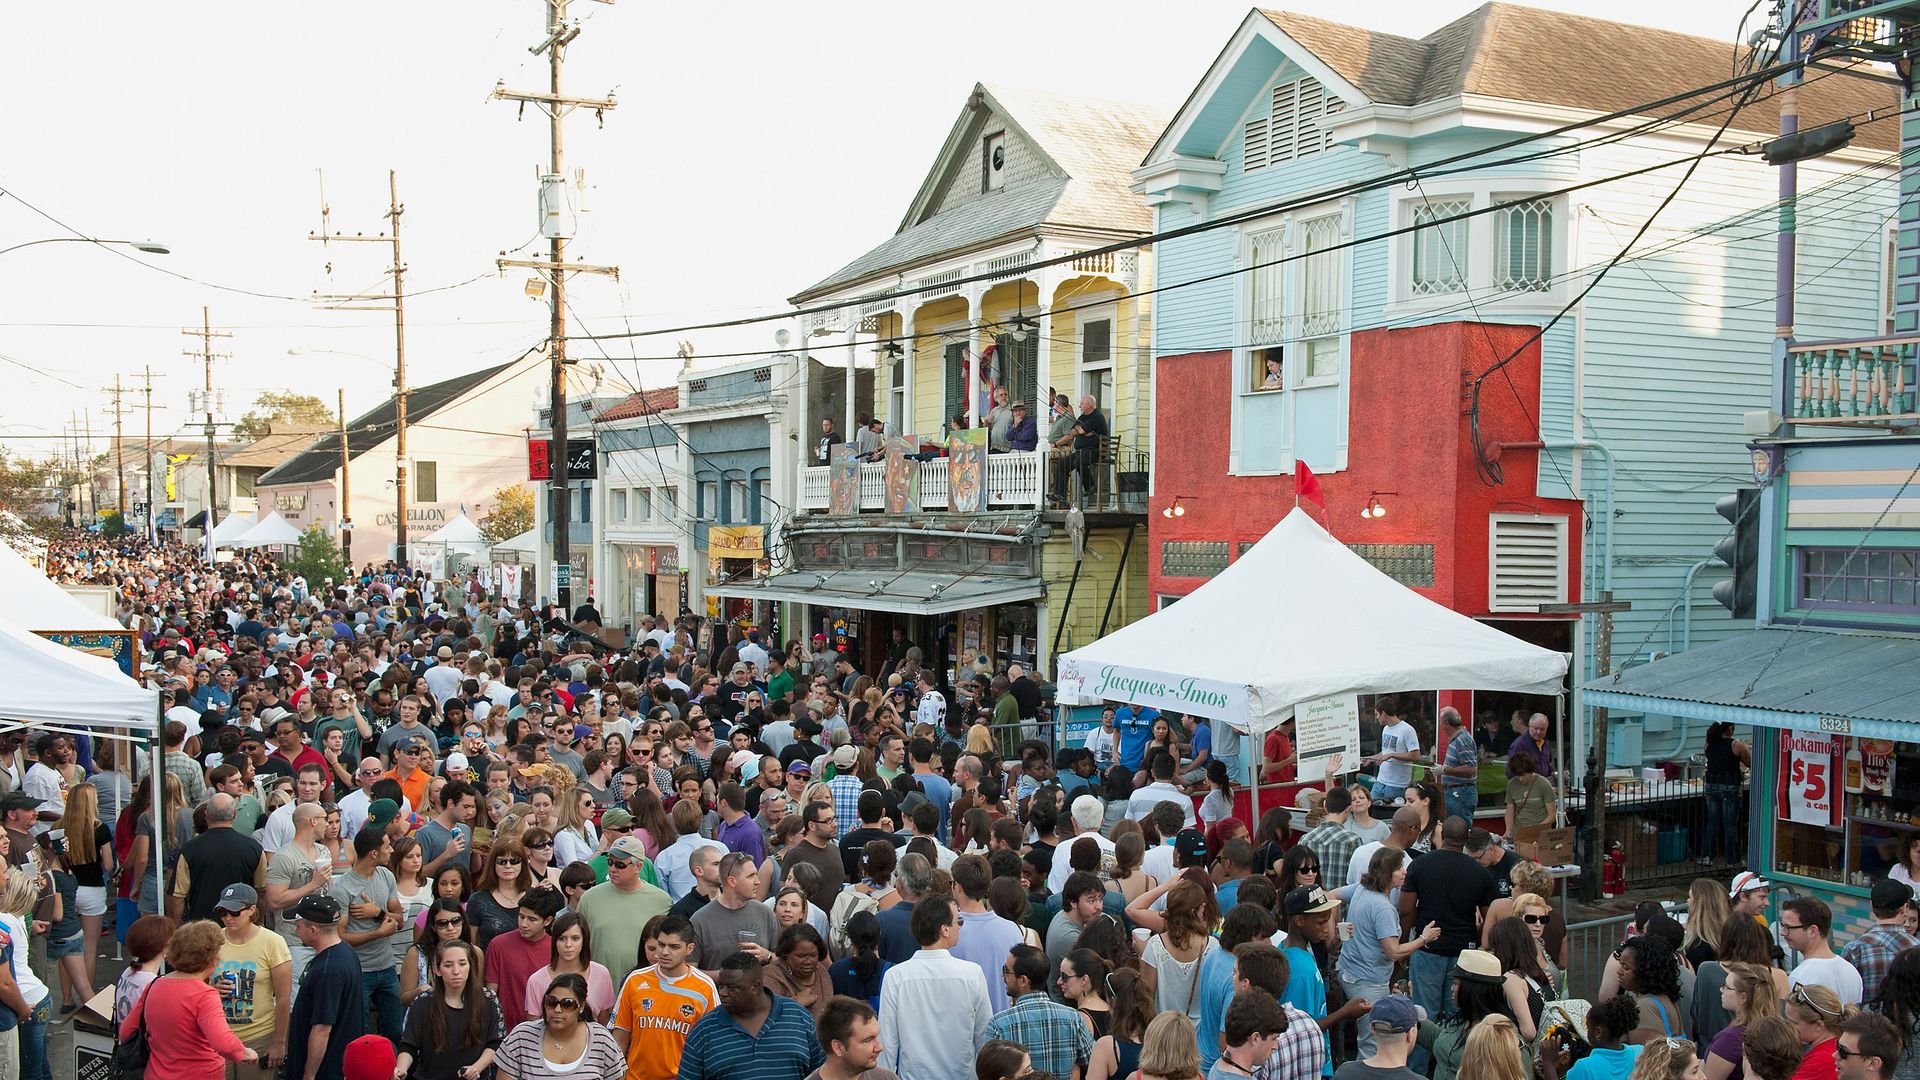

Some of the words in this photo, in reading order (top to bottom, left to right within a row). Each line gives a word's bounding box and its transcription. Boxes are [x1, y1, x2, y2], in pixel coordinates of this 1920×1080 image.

[550, 456, 590, 470] ciba
[376, 509, 445, 527] CASELLON
[393, 524, 445, 532] PARMACY
[1094, 664, 1228, 709] Jacques-Imos
[1821, 718, 1849, 732] 8324
[1782, 735, 1841, 757] Jockamo's
[1867, 752, 1890, 768] Tito's
[1792, 758, 1826, 801] $5
[1814, 803, 1829, 811] can
[639, 1016, 692, 1035] DYNAMO
[80, 1056, 104, 1077] RIVER
[86, 1064, 111, 1080] RISH
